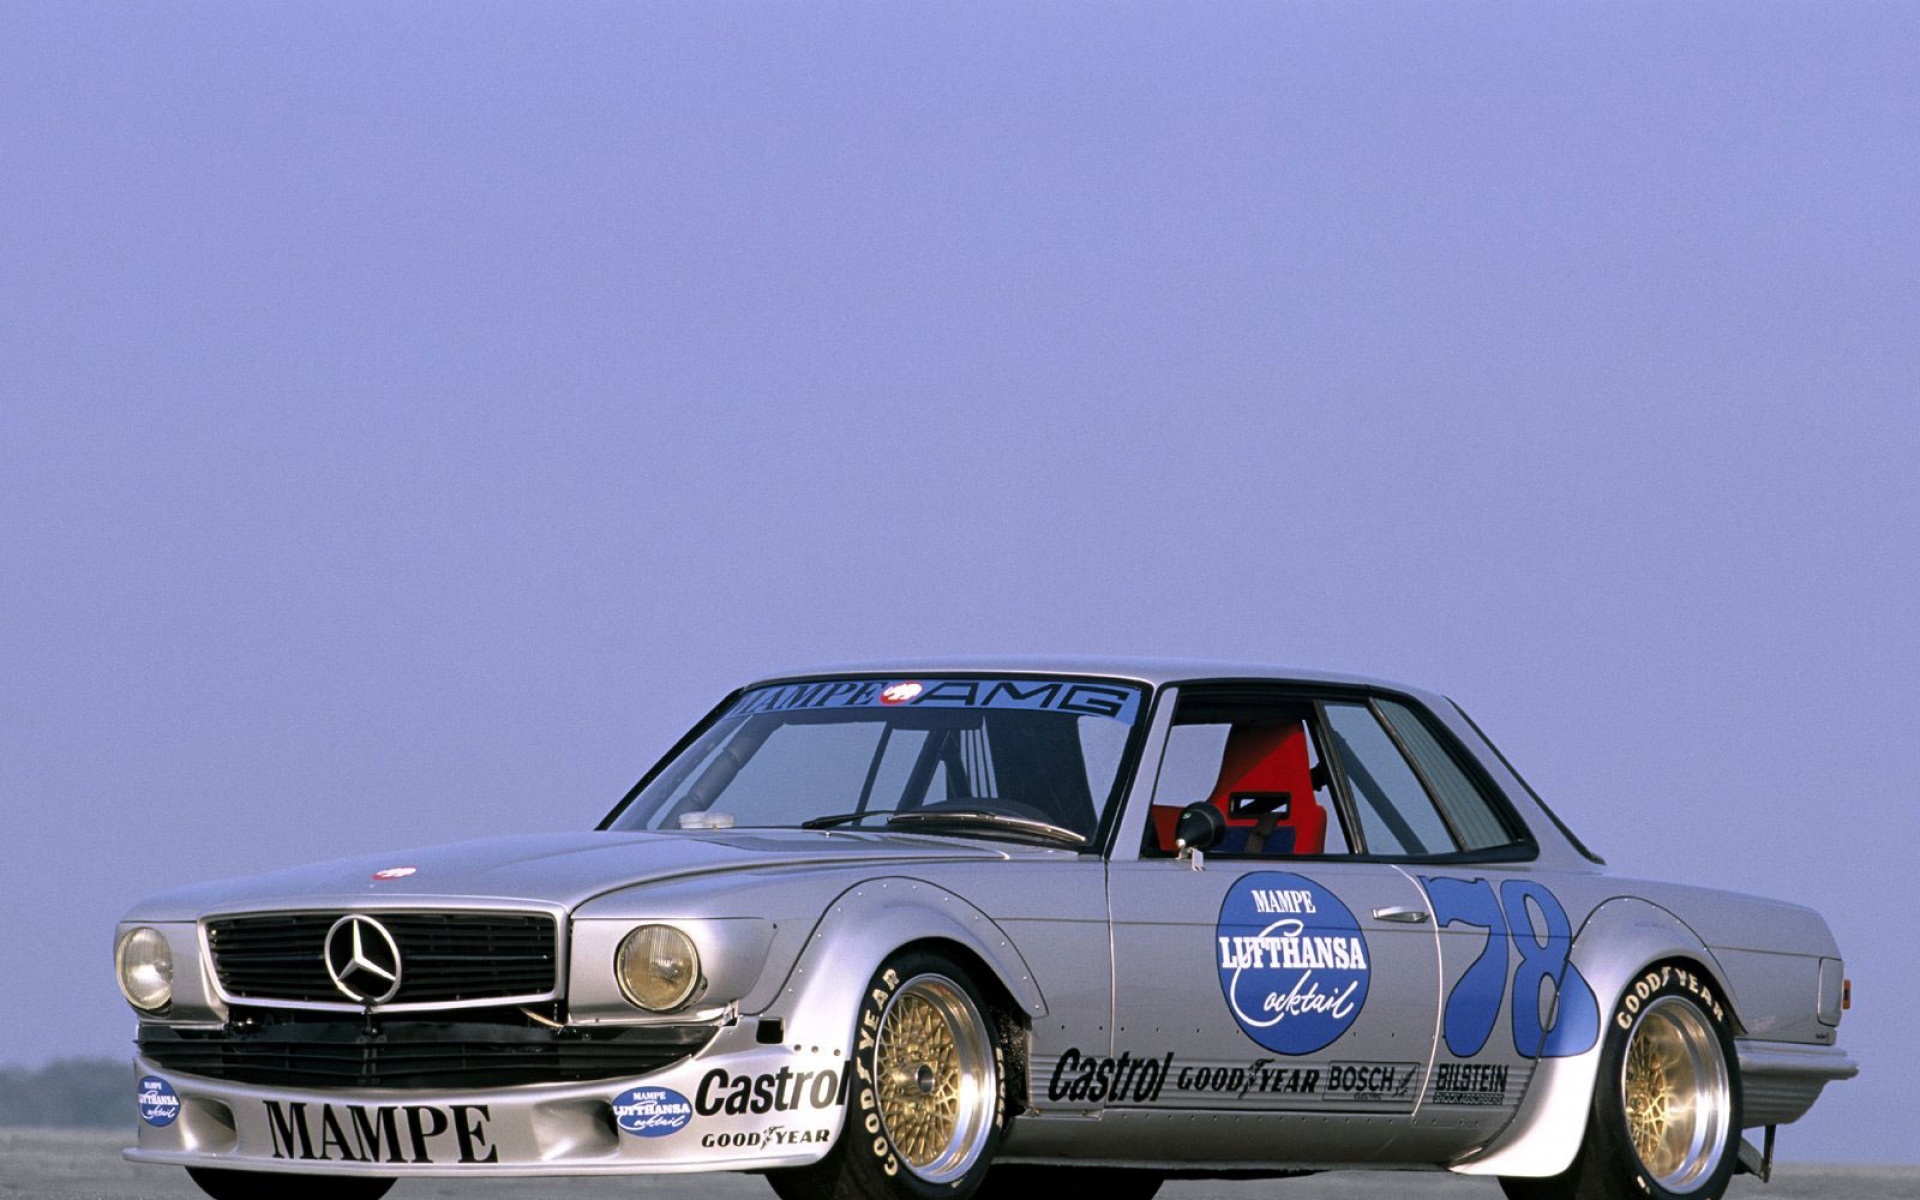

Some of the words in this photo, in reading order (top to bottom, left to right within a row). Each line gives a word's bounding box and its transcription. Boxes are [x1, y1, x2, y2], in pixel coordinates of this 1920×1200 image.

[912, 682, 1128, 718] AMG
[1251, 889, 1317, 914] MAMPE
[1218, 936, 1368, 970] LUFTHANSA
[1416, 875, 1601, 1060] 78
[1229, 918, 1359, 1027] Cocktail
[695, 1060, 851, 1117] Castrol
[1047, 1047, 1175, 1103] Castrol
[1328, 1065, 1396, 1092] BOSCH
[1434, 1063, 1509, 1093] BILSTEIN
[633, 1091, 666, 1100] MAMPE
[263, 1100, 499, 1163] MAMPE
